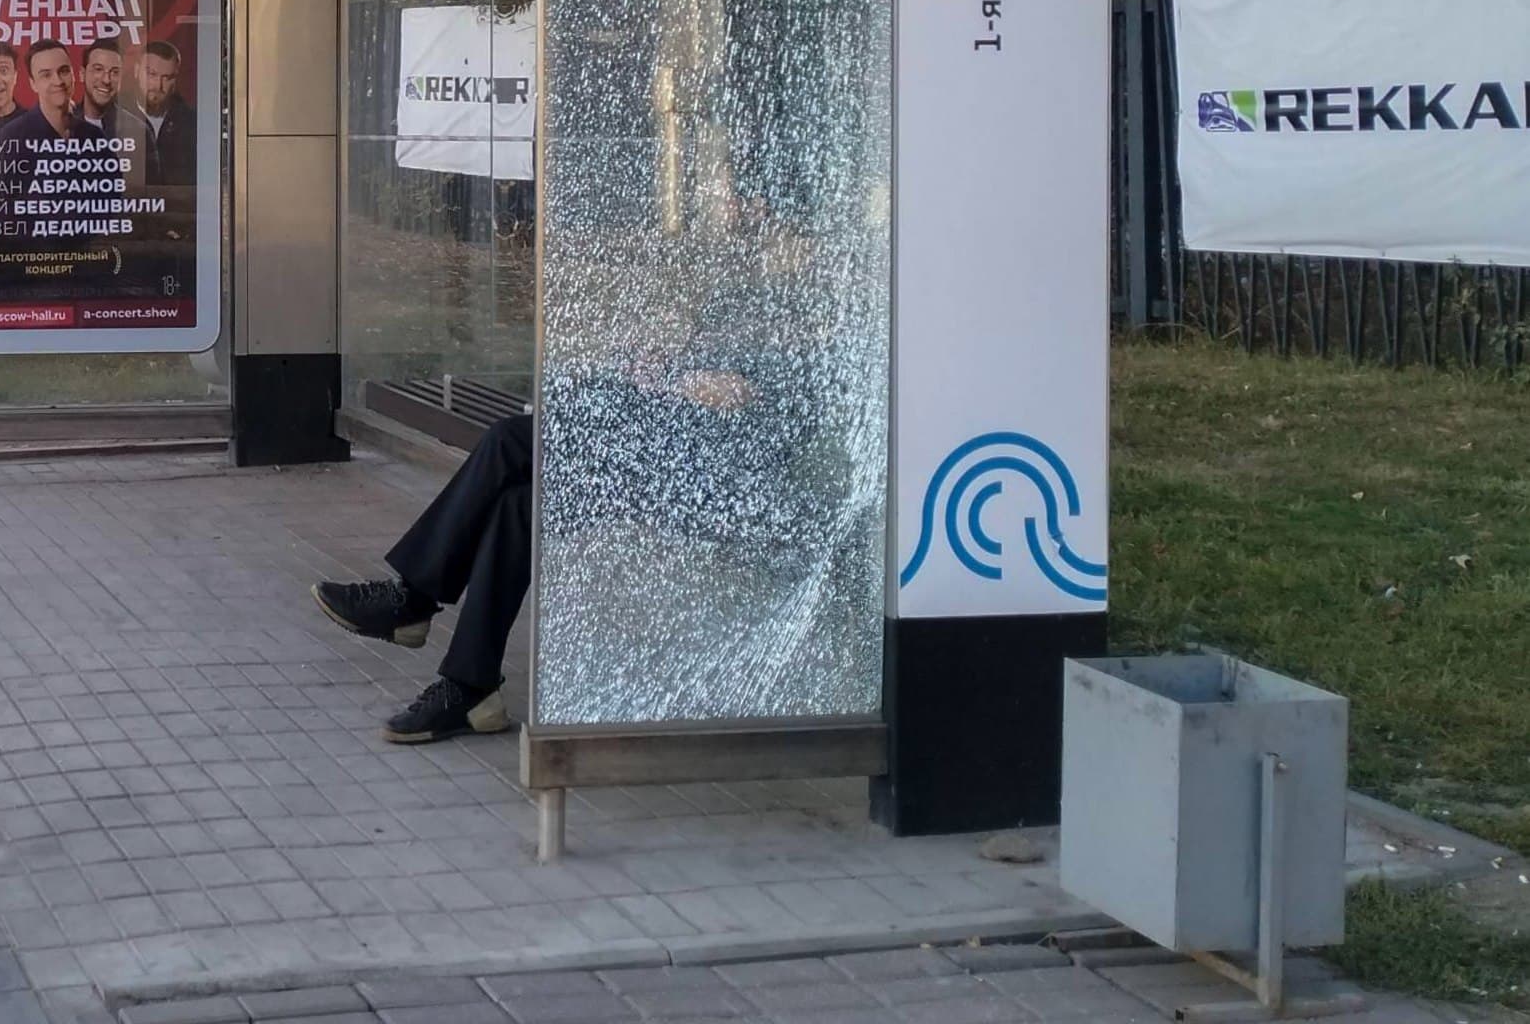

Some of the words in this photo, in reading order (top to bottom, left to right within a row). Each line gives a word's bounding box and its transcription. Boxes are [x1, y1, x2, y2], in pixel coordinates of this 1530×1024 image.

[974, 0, 1003, 51] 1-я
[1263, 81, 1530, 132] REKKA
[25, 138, 136, 154] ЧАБДАРОВ
[34, 158, 132, 174] ДОРОХОВ
[28, 179, 127, 194] АБРАМОВ
[13, 198, 166, 215] БЕБУРИШВИЛИ
[32, 220, 134, 237] ДЕДИЩЕВ
[25, 264, 74, 275] КОНЦЕРТ
[162, 276, 181, 296] 18+
[83, 307, 178, 319] a-concert.show
